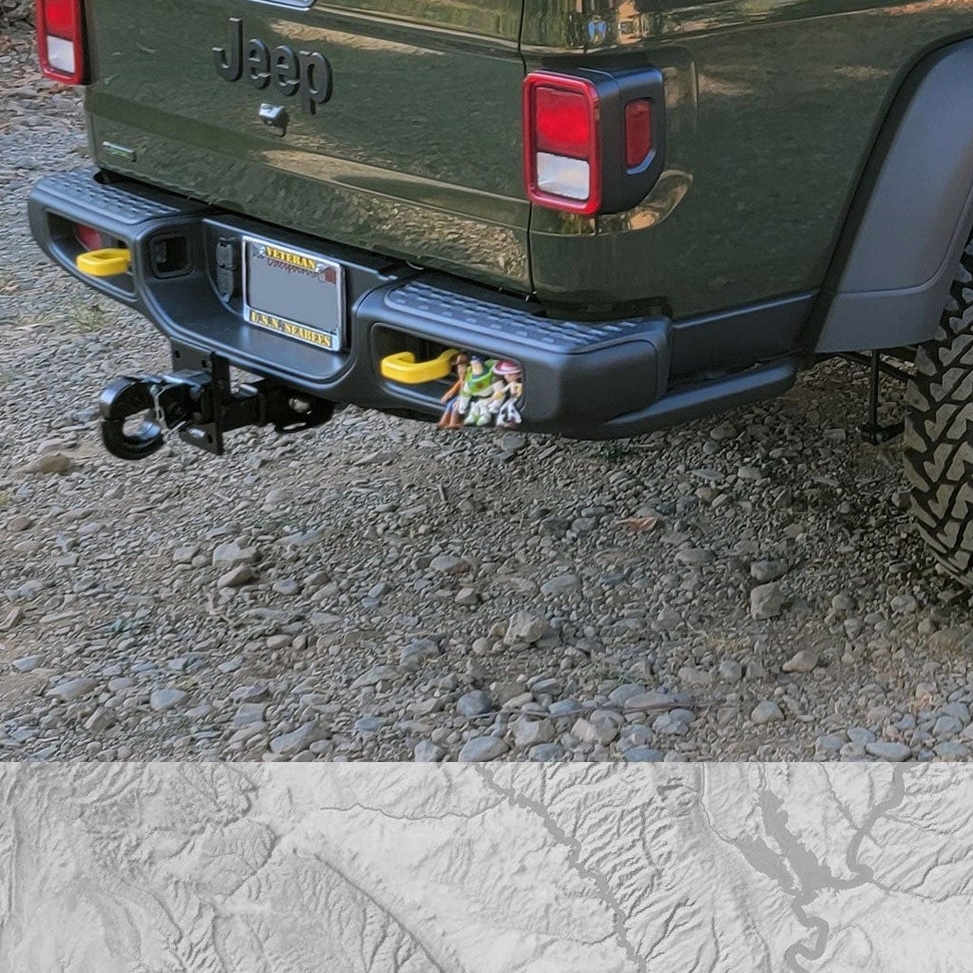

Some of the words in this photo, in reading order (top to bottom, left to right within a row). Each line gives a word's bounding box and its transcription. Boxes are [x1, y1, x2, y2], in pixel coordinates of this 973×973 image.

[212, 17, 333, 116] Jeep
[266, 246, 317, 271] VETERAN
[250, 310, 283, 330] U.S.N.
[283, 322, 331, 347] SEABEES
